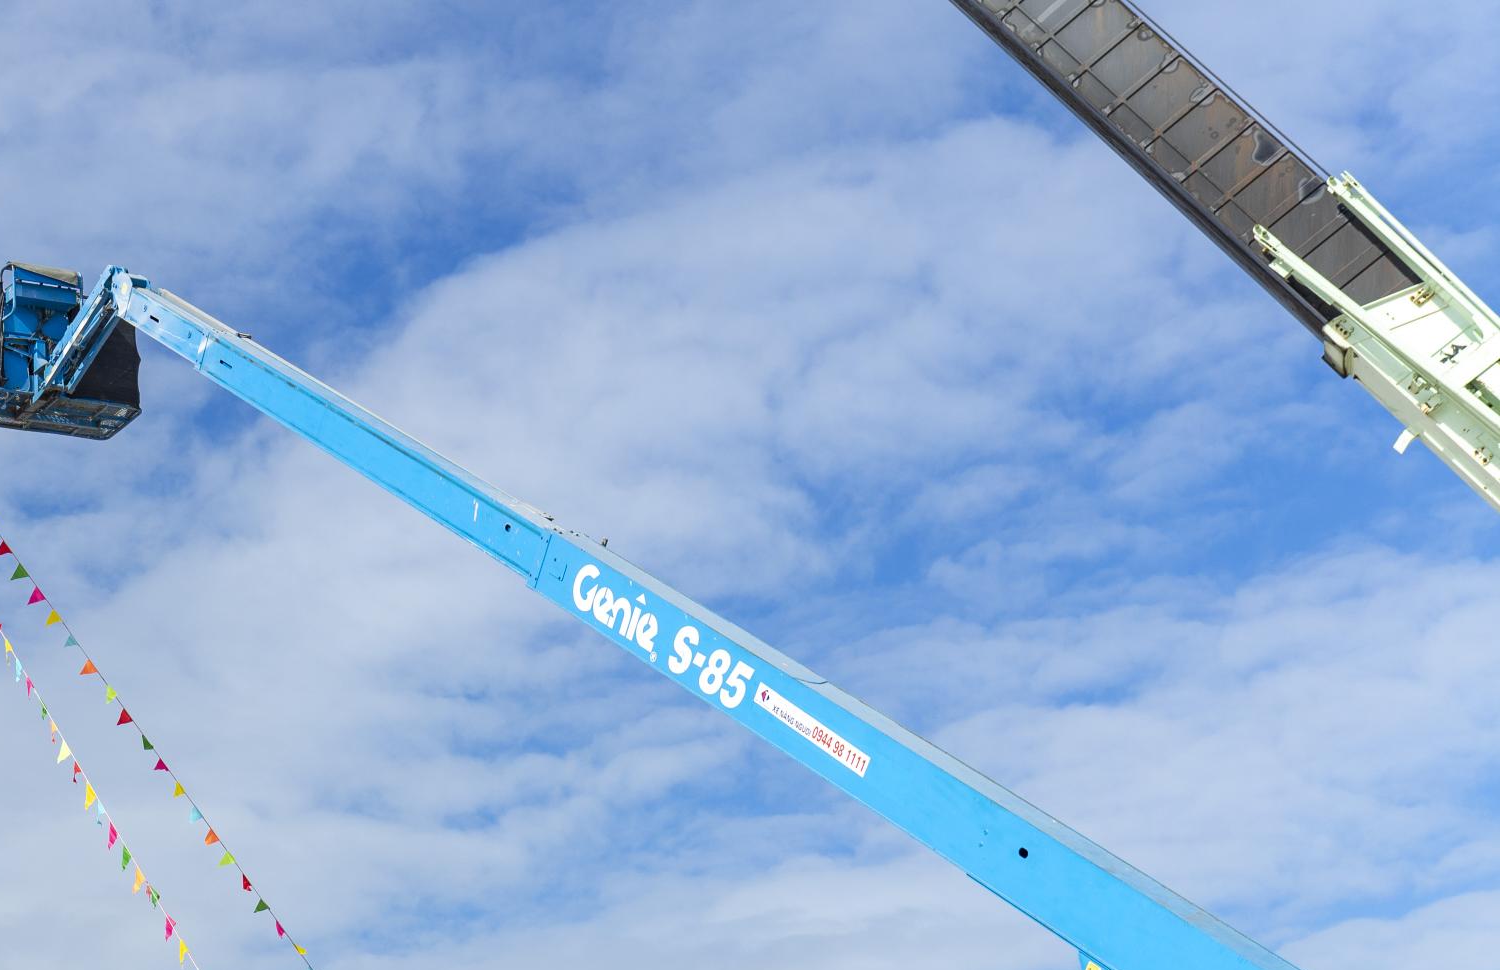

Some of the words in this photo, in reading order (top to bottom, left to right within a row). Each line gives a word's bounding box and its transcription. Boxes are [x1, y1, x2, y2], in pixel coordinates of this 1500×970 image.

[573, 564, 658, 653] Genie
[667, 625, 755, 709] S-85
[812, 726, 833, 749] 0944
[832, 741, 845, 757] 98
[845, 750, 867, 772] 1111
